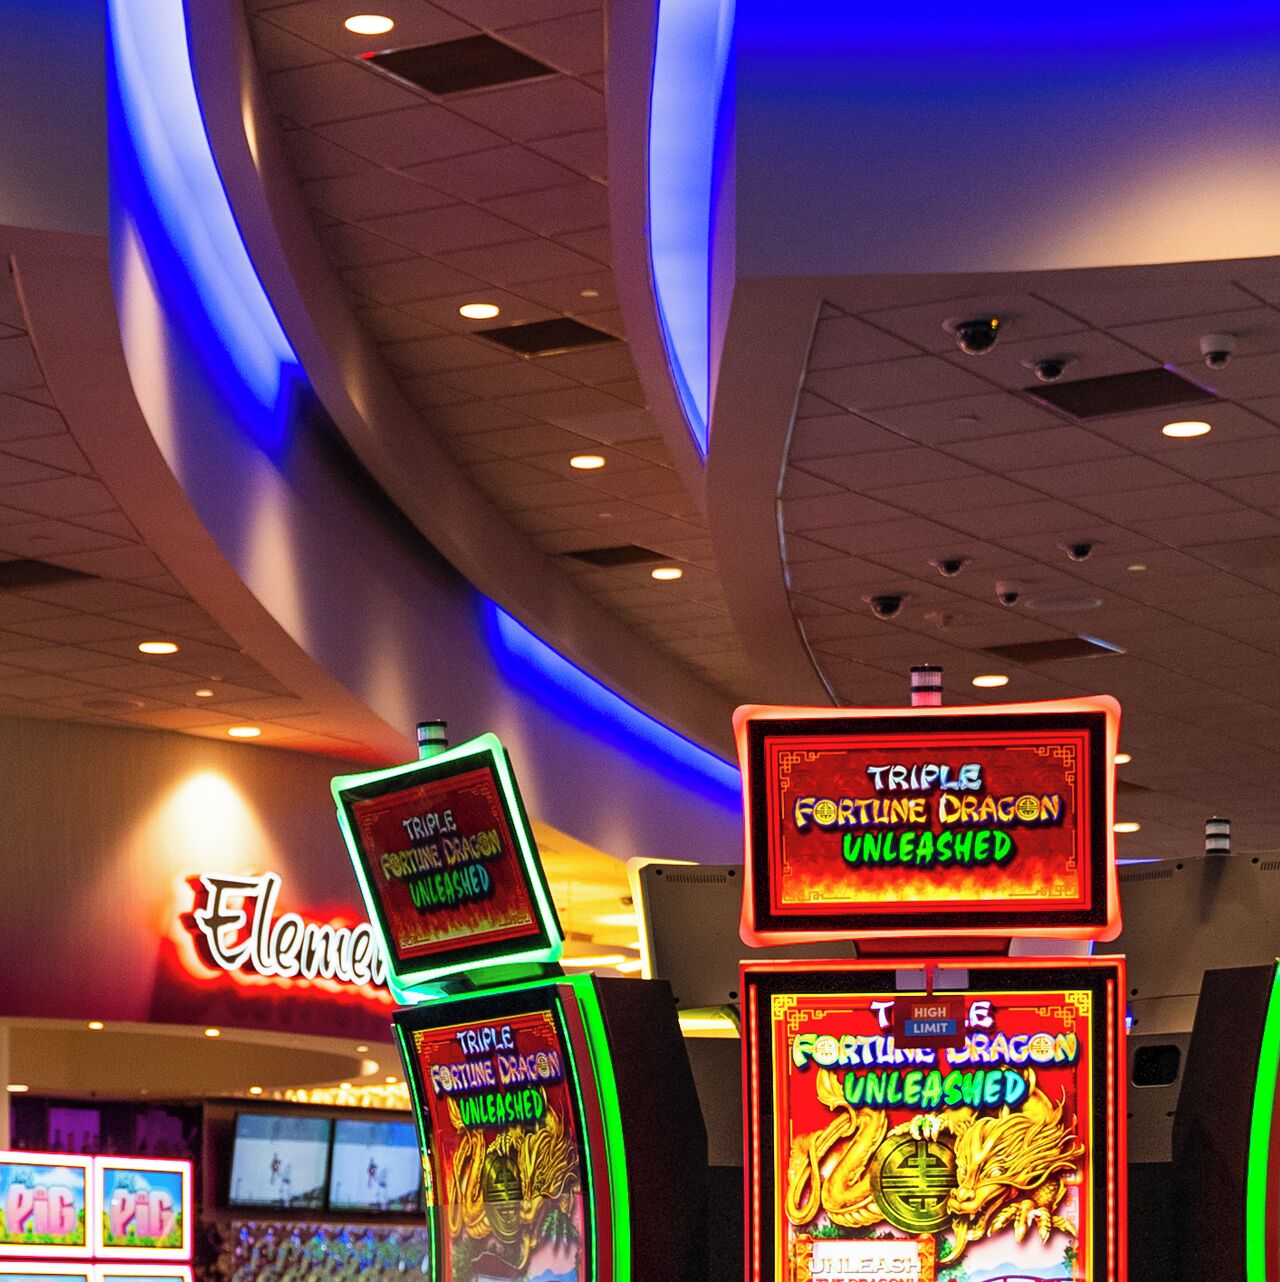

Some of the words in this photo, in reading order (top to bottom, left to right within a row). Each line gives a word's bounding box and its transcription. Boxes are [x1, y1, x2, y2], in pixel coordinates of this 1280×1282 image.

[867, 762, 983, 791] TRIPLE
[402, 809, 457, 841] TRIPLE
[794, 795, 927, 829] FORTUNE
[939, 792, 1061, 825] DRAGON
[380, 843, 442, 882] FORTUNE
[442, 828, 503, 866] DRAGON
[842, 829, 1012, 866] UNLEASHED
[409, 863, 490, 910] UNLEASHED
[913, 1022, 949, 1034] LIMIT
[914, 1006, 948, 1018] HIGH
[456, 1025, 515, 1055] TRIPLE
[430, 1060, 497, 1095] FORTUNE
[497, 1051, 561, 1086] DRAGON
[843, 1069, 1026, 1109] UNLEASHED
[459, 1088, 544, 1126] UNLEASHED
[808, 1256, 923, 1274] UNLEASH
